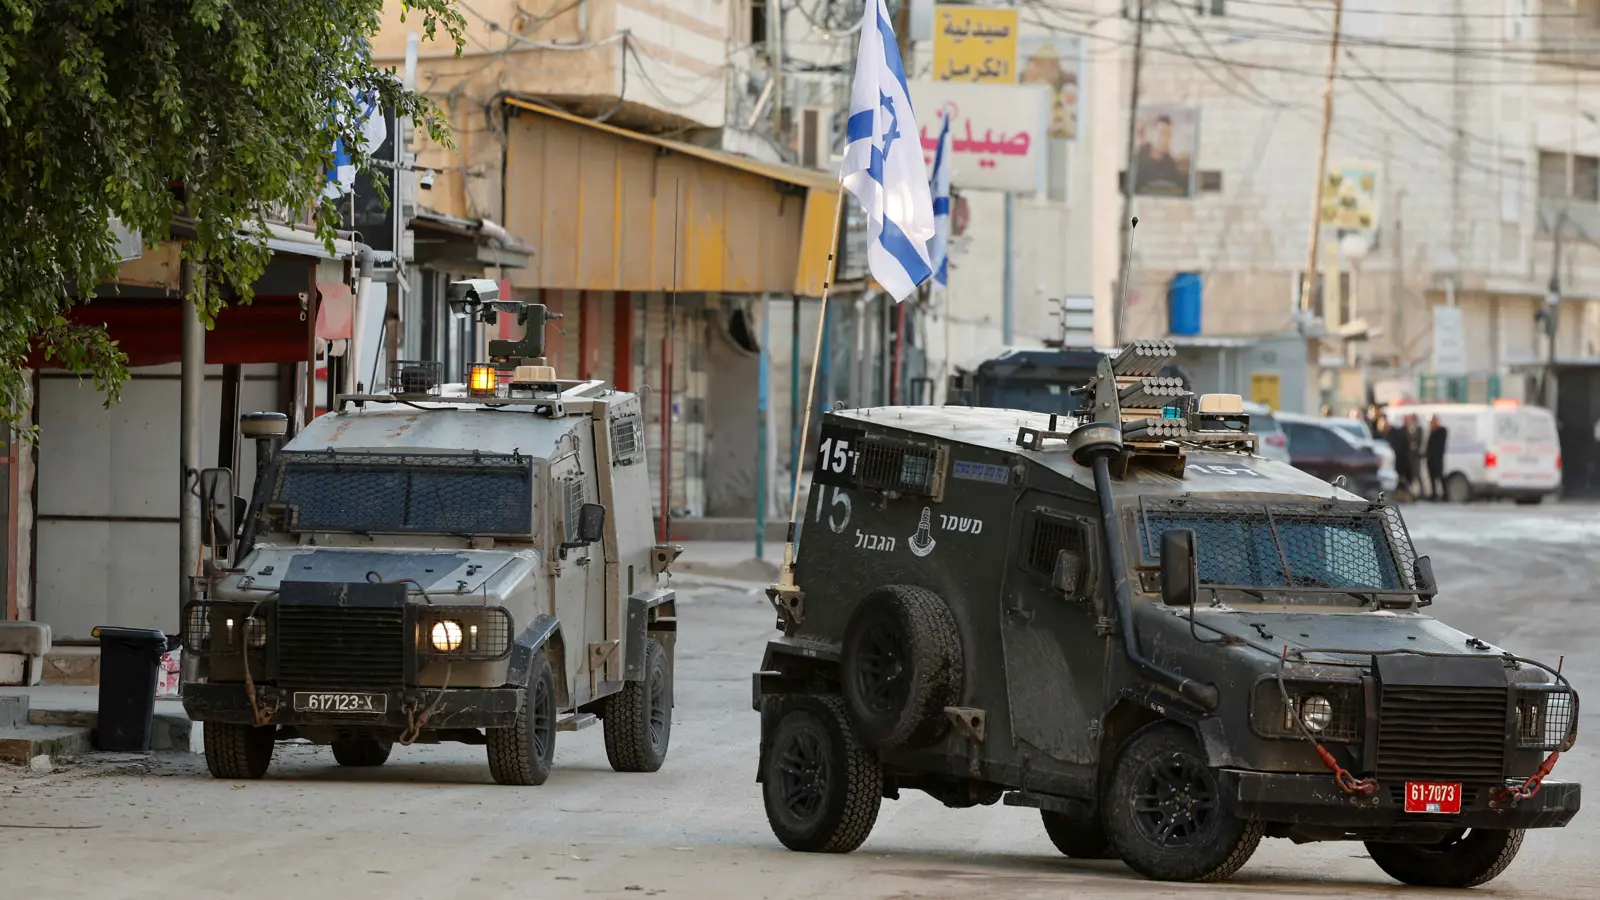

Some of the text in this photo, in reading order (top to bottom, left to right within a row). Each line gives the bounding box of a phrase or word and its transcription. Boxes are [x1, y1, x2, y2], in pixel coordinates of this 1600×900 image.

[942, 13, 1011, 44] صيدلية
[940, 57, 1010, 82] الكرمل
[815, 483, 852, 534] 15
[940, 513, 983, 535] משמר
[854, 528, 896, 552] הגבול
